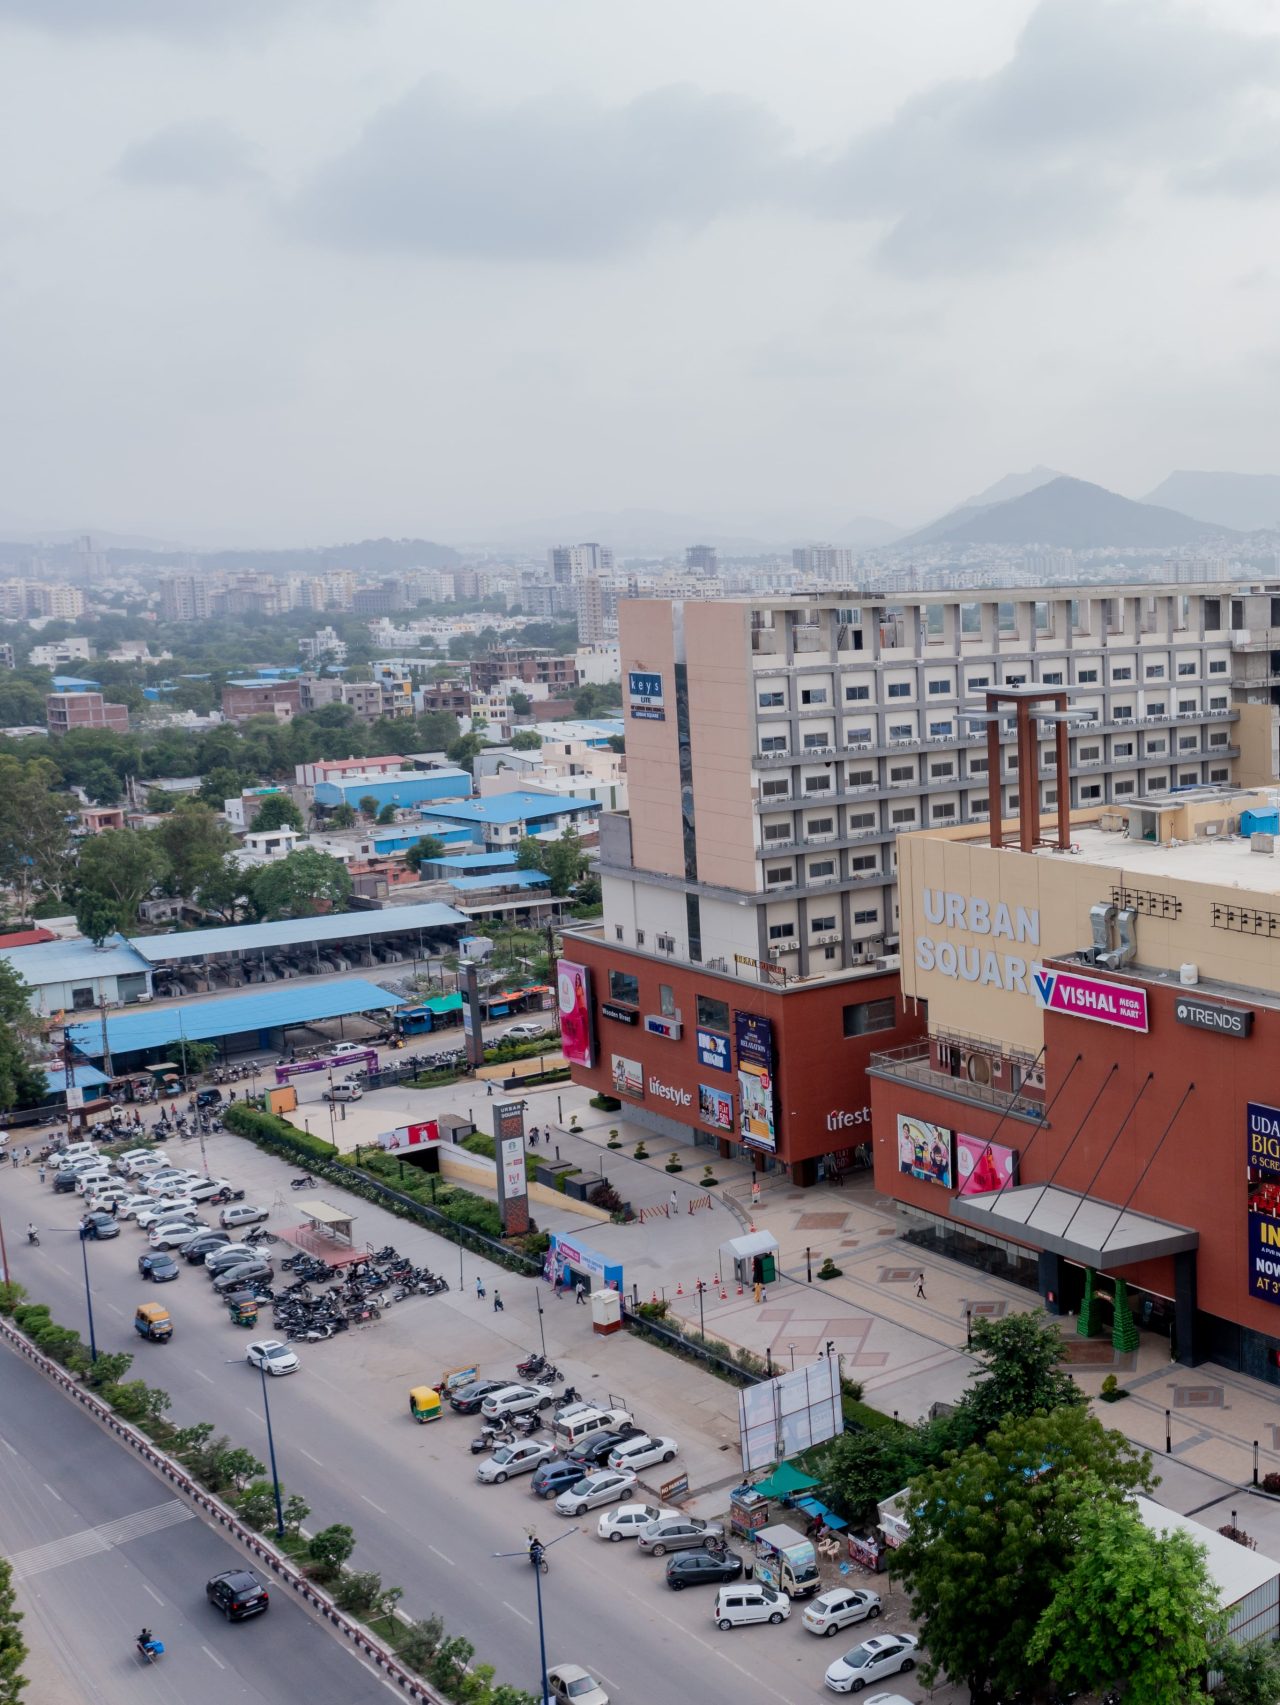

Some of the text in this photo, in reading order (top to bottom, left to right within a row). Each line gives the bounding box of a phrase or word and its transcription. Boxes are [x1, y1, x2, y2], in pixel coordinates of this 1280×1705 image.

[631, 675, 659, 694] keys
[923, 888, 1041, 947] URBAN
[1059, 984, 1117, 1013] VISHAL
[1119, 997, 1140, 1009] MEGA
[1119, 1008, 1140, 1019] MART
[1187, 1006, 1242, 1031] TRENDS
[649, 1076, 692, 1106] lifestyle
[827, 1106, 873, 1131] lifest
[1251, 1155, 1257, 1165] 6
[1256, 1276, 1269, 1291] AT
